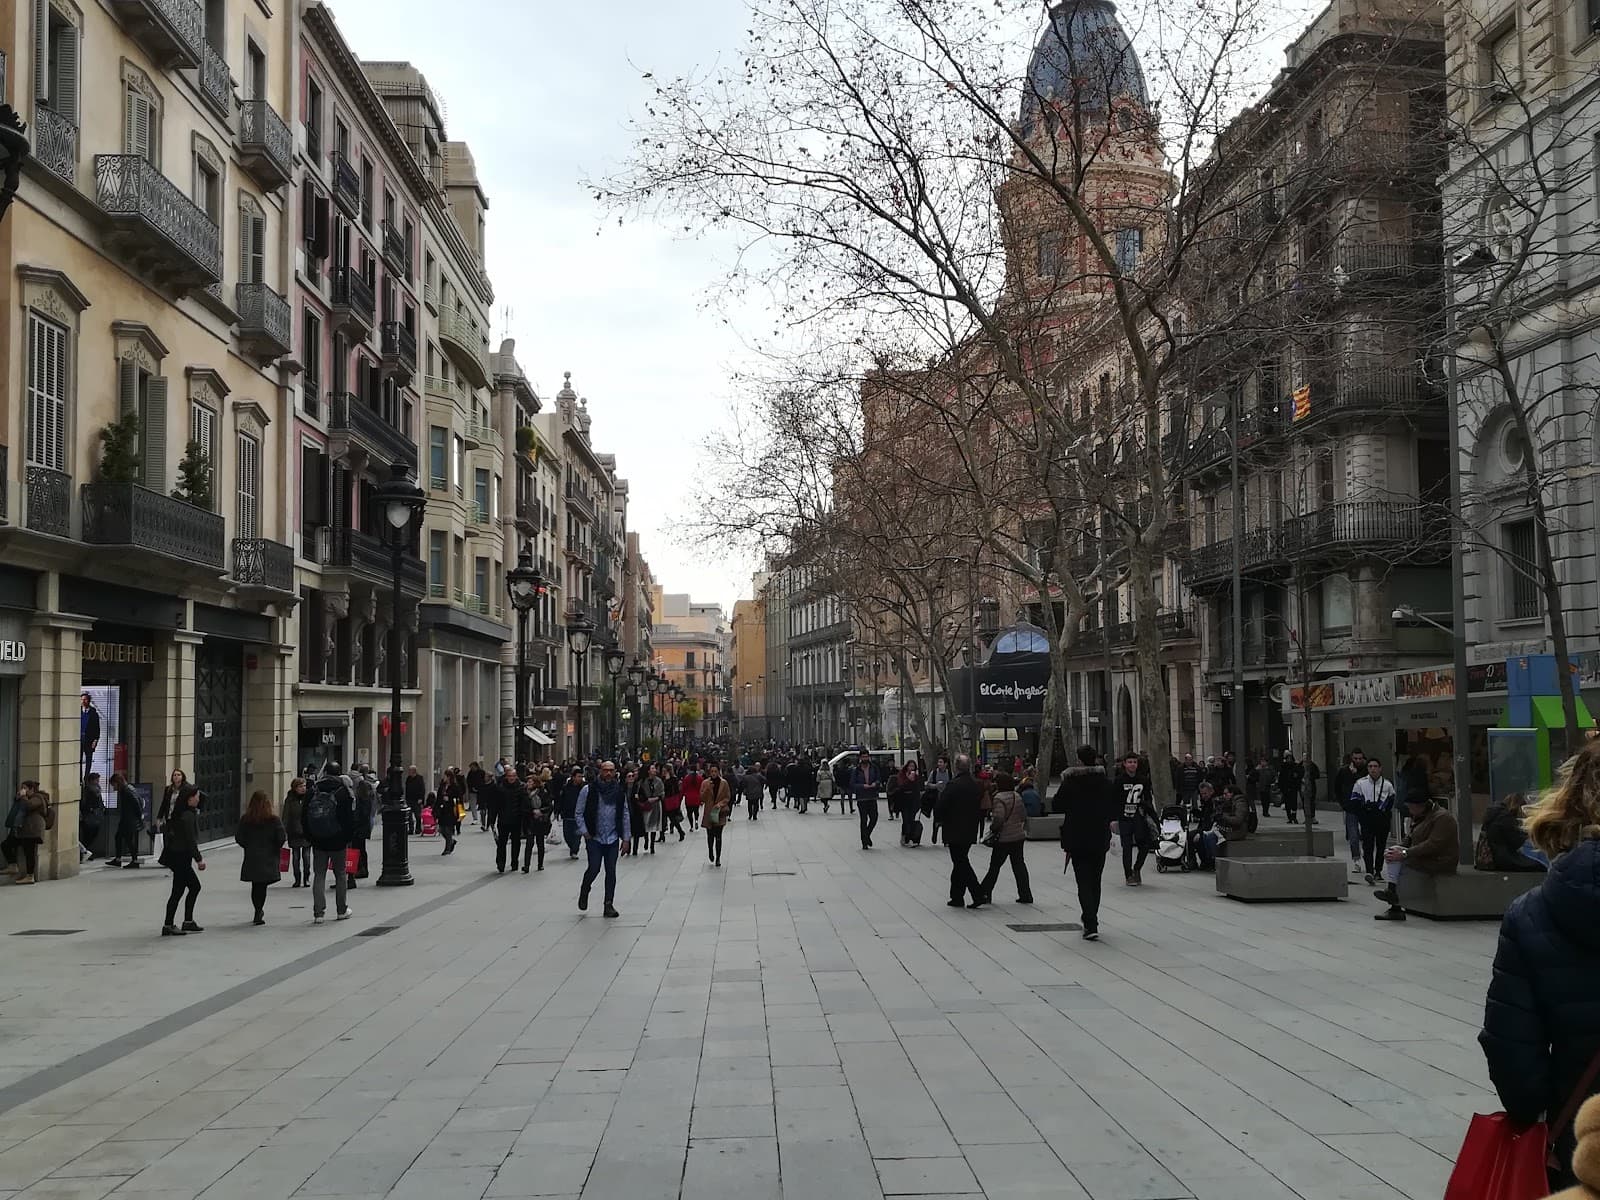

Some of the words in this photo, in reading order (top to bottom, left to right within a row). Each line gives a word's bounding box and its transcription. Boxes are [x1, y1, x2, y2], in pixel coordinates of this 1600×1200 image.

[980, 682, 990, 696] El
[990, 683, 1014, 696] Corte
[1013, 680, 1048, 700] Inglés
[1123, 783, 1144, 804] 72
